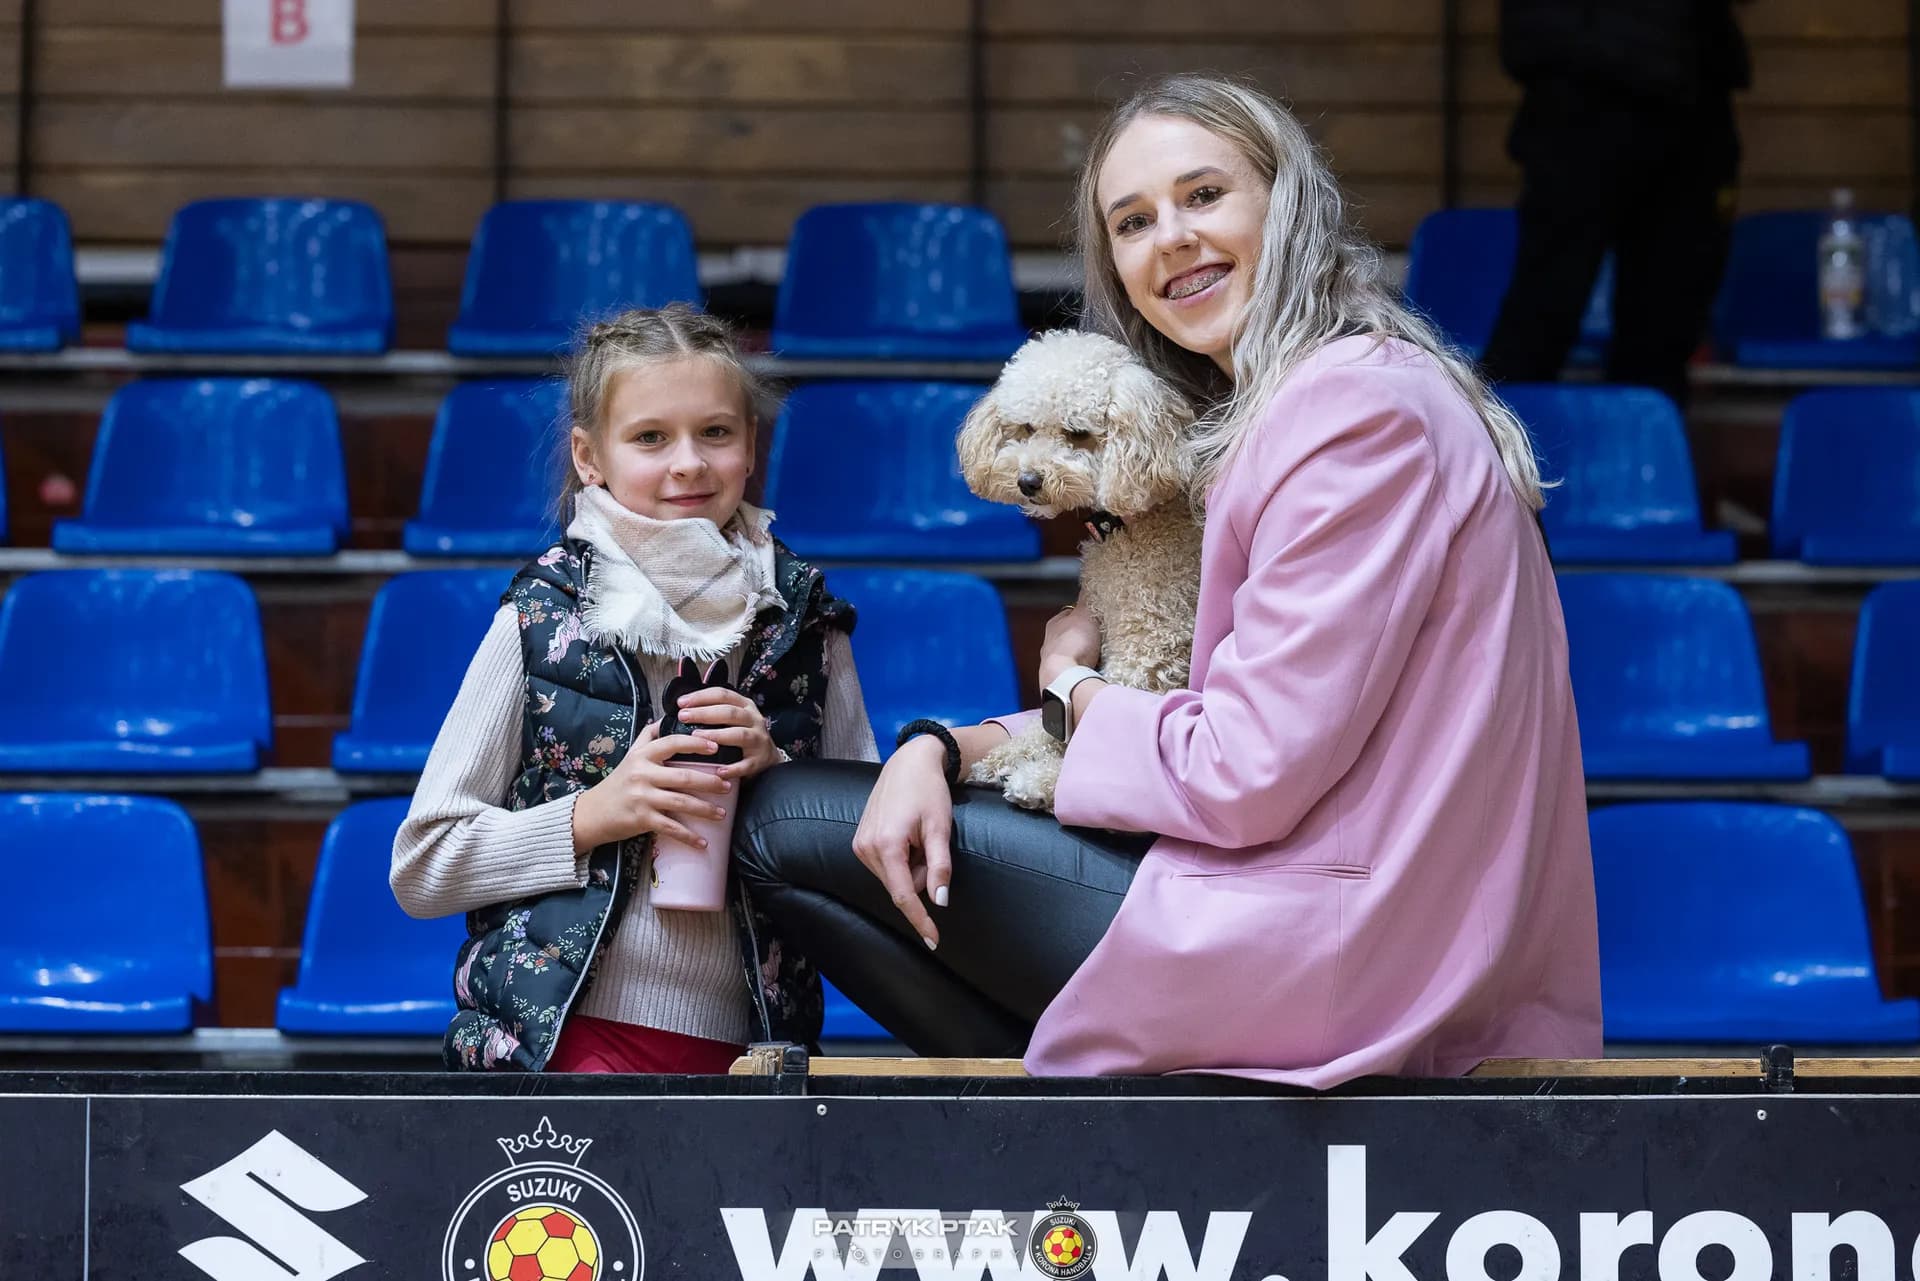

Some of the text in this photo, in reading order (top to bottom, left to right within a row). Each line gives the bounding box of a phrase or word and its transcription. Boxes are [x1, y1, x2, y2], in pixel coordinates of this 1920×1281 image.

[270, 0, 310, 46] B
[506, 1177, 582, 1203] SUZUKI
[720, 1145, 1920, 1281] wwwkoron
